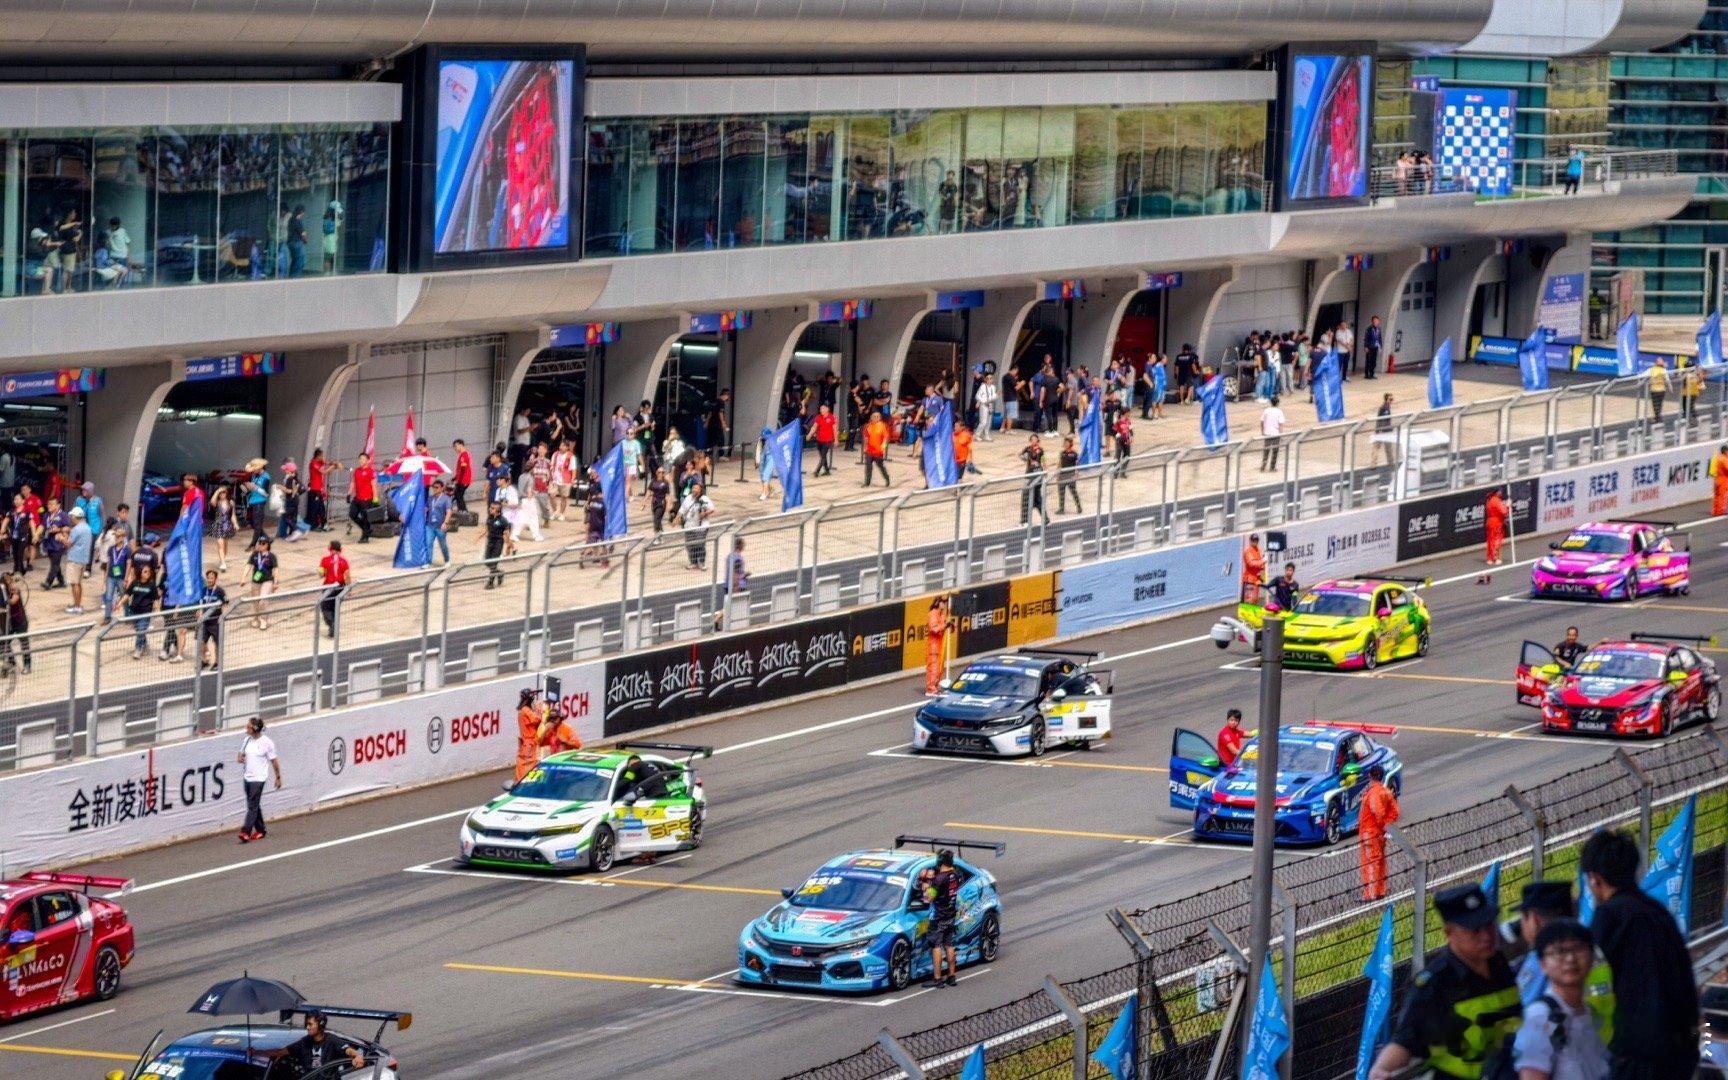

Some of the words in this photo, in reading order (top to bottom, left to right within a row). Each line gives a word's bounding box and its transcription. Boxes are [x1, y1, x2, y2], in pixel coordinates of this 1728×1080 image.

[1552, 583, 1588, 593] CIVIC
[759, 641, 801, 672] ARTKA
[806, 631, 847, 663] ARTKA
[660, 661, 704, 694] ARTKA
[709, 650, 753, 682] ARTKA
[607, 670, 653, 704] ARTKA
[558, 692, 589, 720] SCH
[451, 710, 500, 743] BOSCH
[938, 734, 980, 747] CIVIC
[353, 729, 407, 764] BOSCH
[68, 774, 172, 832] 全新凌渡L
[180, 762, 225, 806] GTS
[482, 846, 529, 860] CIVIC
